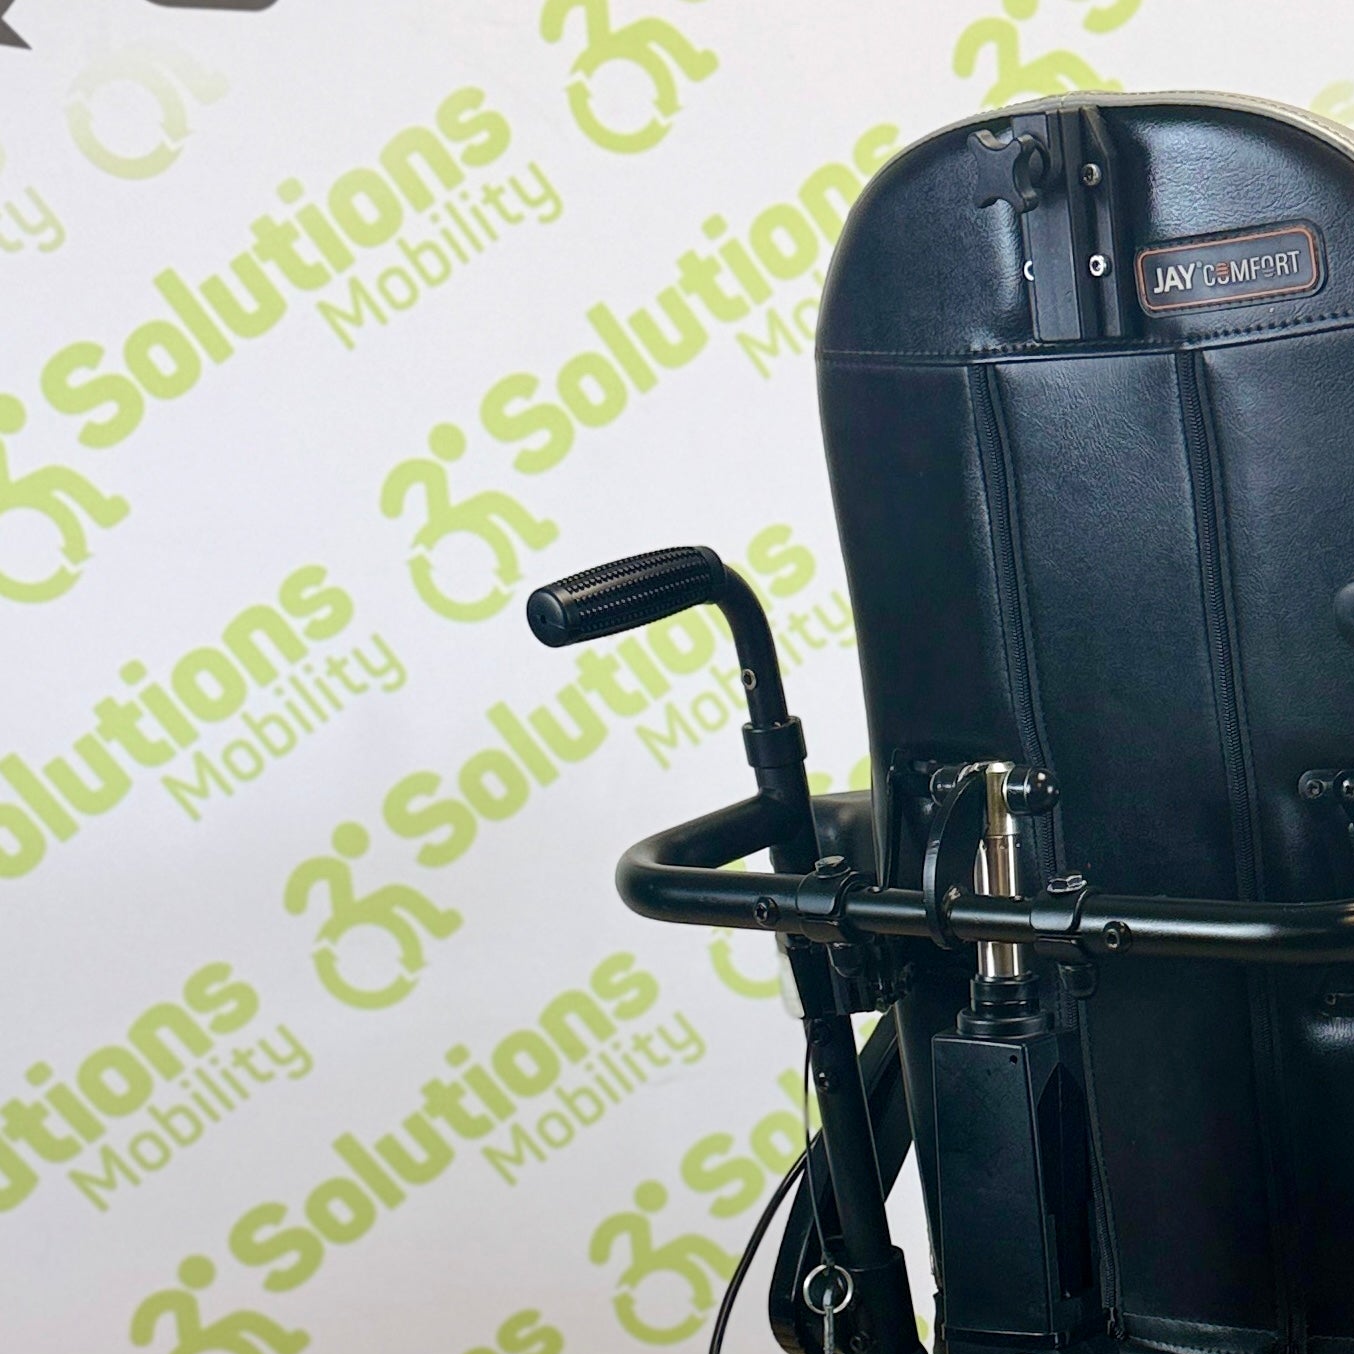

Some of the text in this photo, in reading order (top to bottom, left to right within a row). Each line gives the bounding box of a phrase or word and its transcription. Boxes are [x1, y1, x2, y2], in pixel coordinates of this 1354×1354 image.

[40, 86, 511, 449] Solutions
[316, 161, 564, 350] Mobility
[1153, 250, 1301, 294] JAY COMFORT
[0, 565, 354, 880] olutions
[161, 633, 408, 822] Mobility
[0, 961, 260, 1215] tions
[68, 1023, 314, 1212] Mobility
[228, 951, 661, 1293] Solutions
[481, 1005, 707, 1187] Mobility
